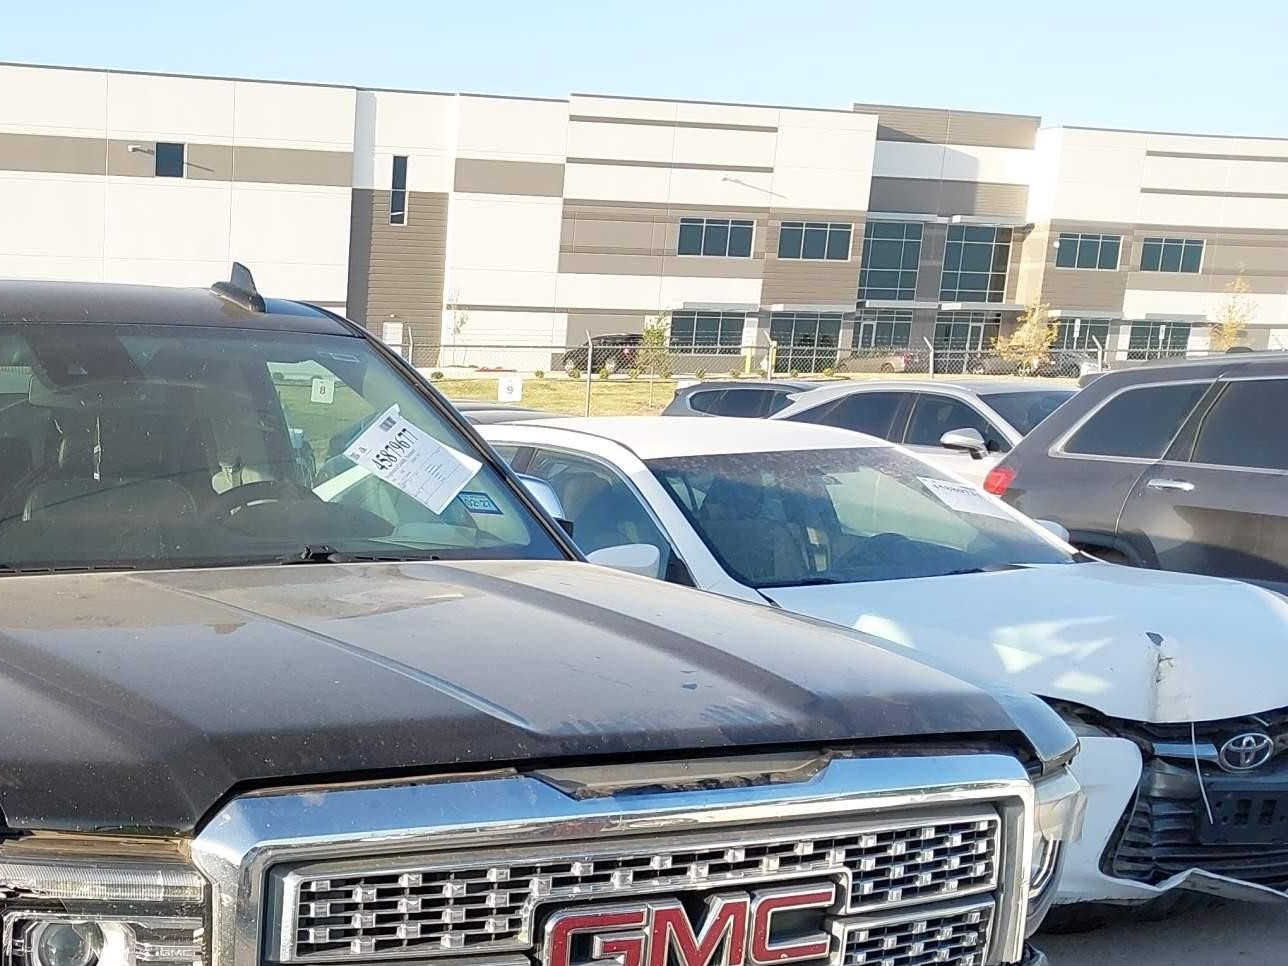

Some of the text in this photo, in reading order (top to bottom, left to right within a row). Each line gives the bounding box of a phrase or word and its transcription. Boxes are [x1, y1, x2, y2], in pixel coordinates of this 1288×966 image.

[506, 385, 514, 394] 9
[372, 428, 419, 471] 45879677
[159, 949, 193, 957] GMC
